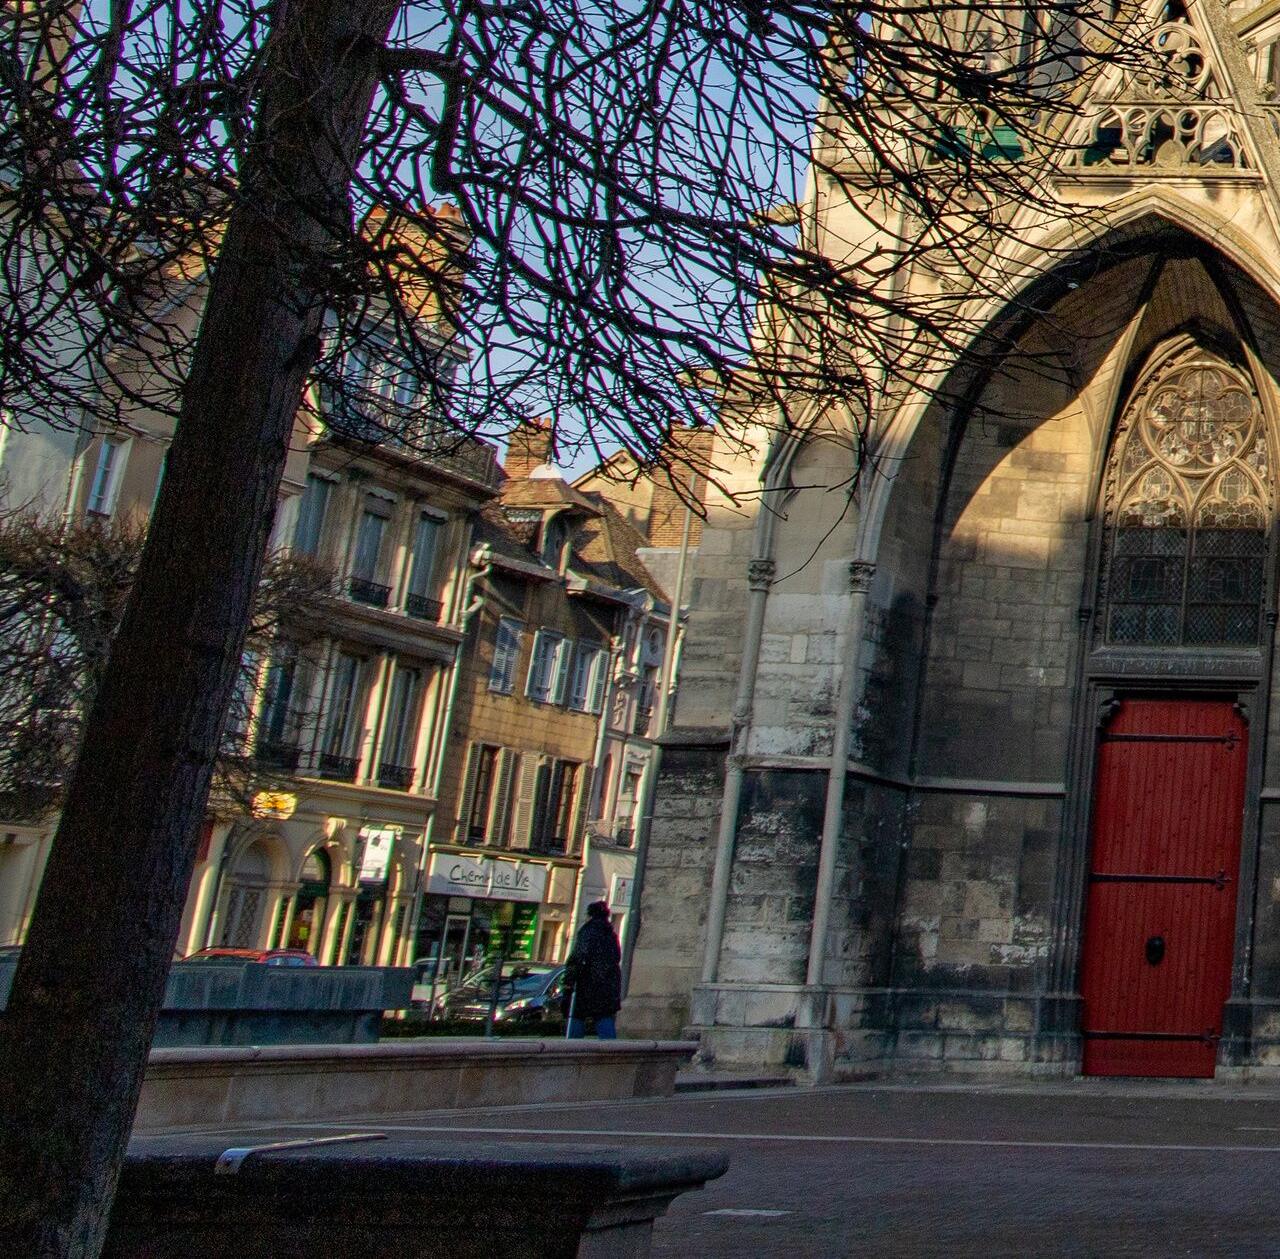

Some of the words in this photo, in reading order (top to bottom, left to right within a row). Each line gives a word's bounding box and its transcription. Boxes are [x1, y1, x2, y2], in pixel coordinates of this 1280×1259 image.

[449, 865, 492, 883] Chem
[496, 871, 510, 886] de
[515, 869, 530, 887] Vie
